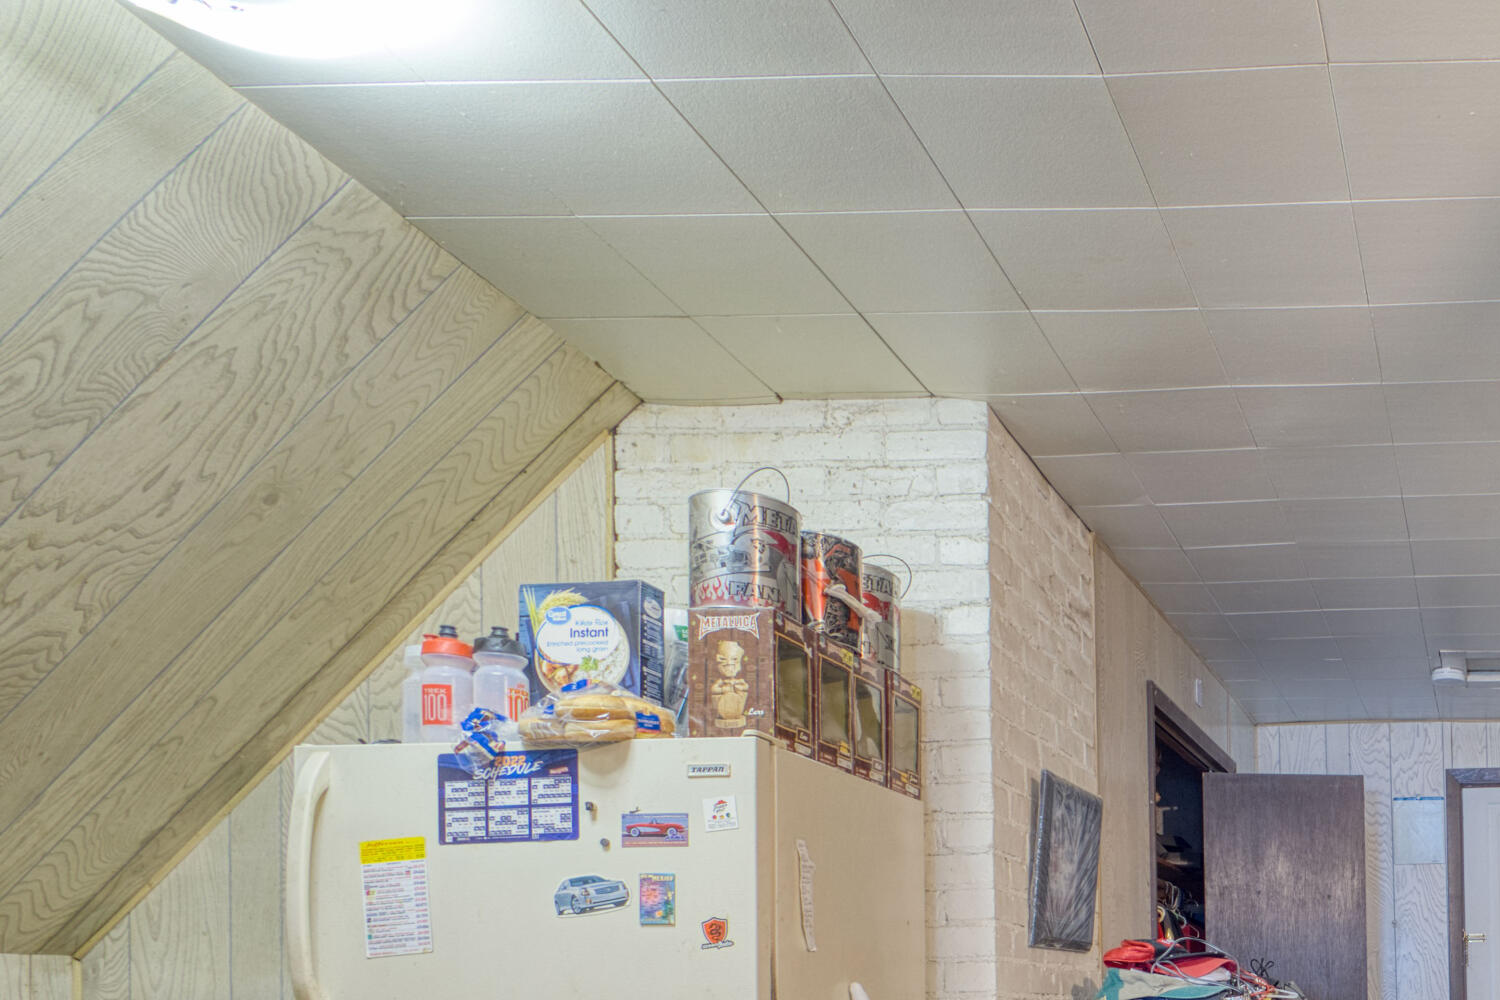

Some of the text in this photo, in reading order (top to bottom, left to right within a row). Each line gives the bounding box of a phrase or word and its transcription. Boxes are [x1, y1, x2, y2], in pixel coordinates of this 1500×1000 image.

[729, 581, 780, 602] FAN
[570, 627, 609, 638] Instant
[696, 612, 760, 640] METALLICA
[424, 694, 447, 721] 100
[473, 761, 544, 780] SCHEDULE
[495, 755, 526, 767] 2022
